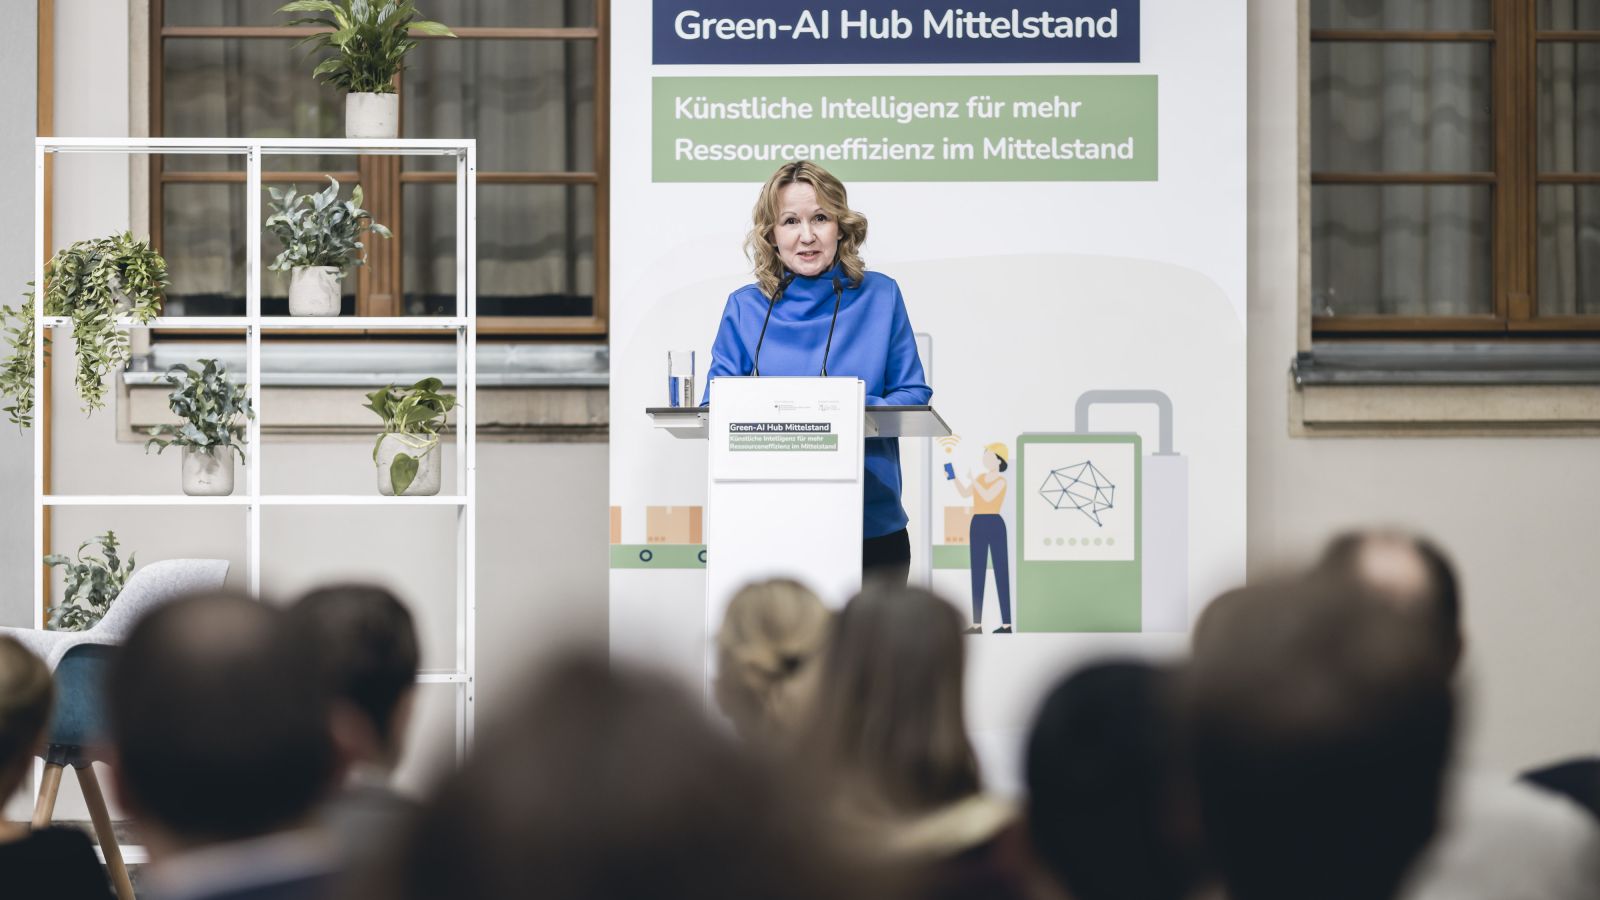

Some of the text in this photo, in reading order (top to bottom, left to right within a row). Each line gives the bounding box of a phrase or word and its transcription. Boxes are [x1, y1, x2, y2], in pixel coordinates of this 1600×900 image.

[674, 8, 1118, 40] Green-AI Hub Mittelstand
[675, 95, 1082, 124] Künstliche Intelligenz für mehr
[675, 136, 1134, 161] Ressourceneffizienz im Mittelstand
[763, 435, 796, 443] Intelligenz
